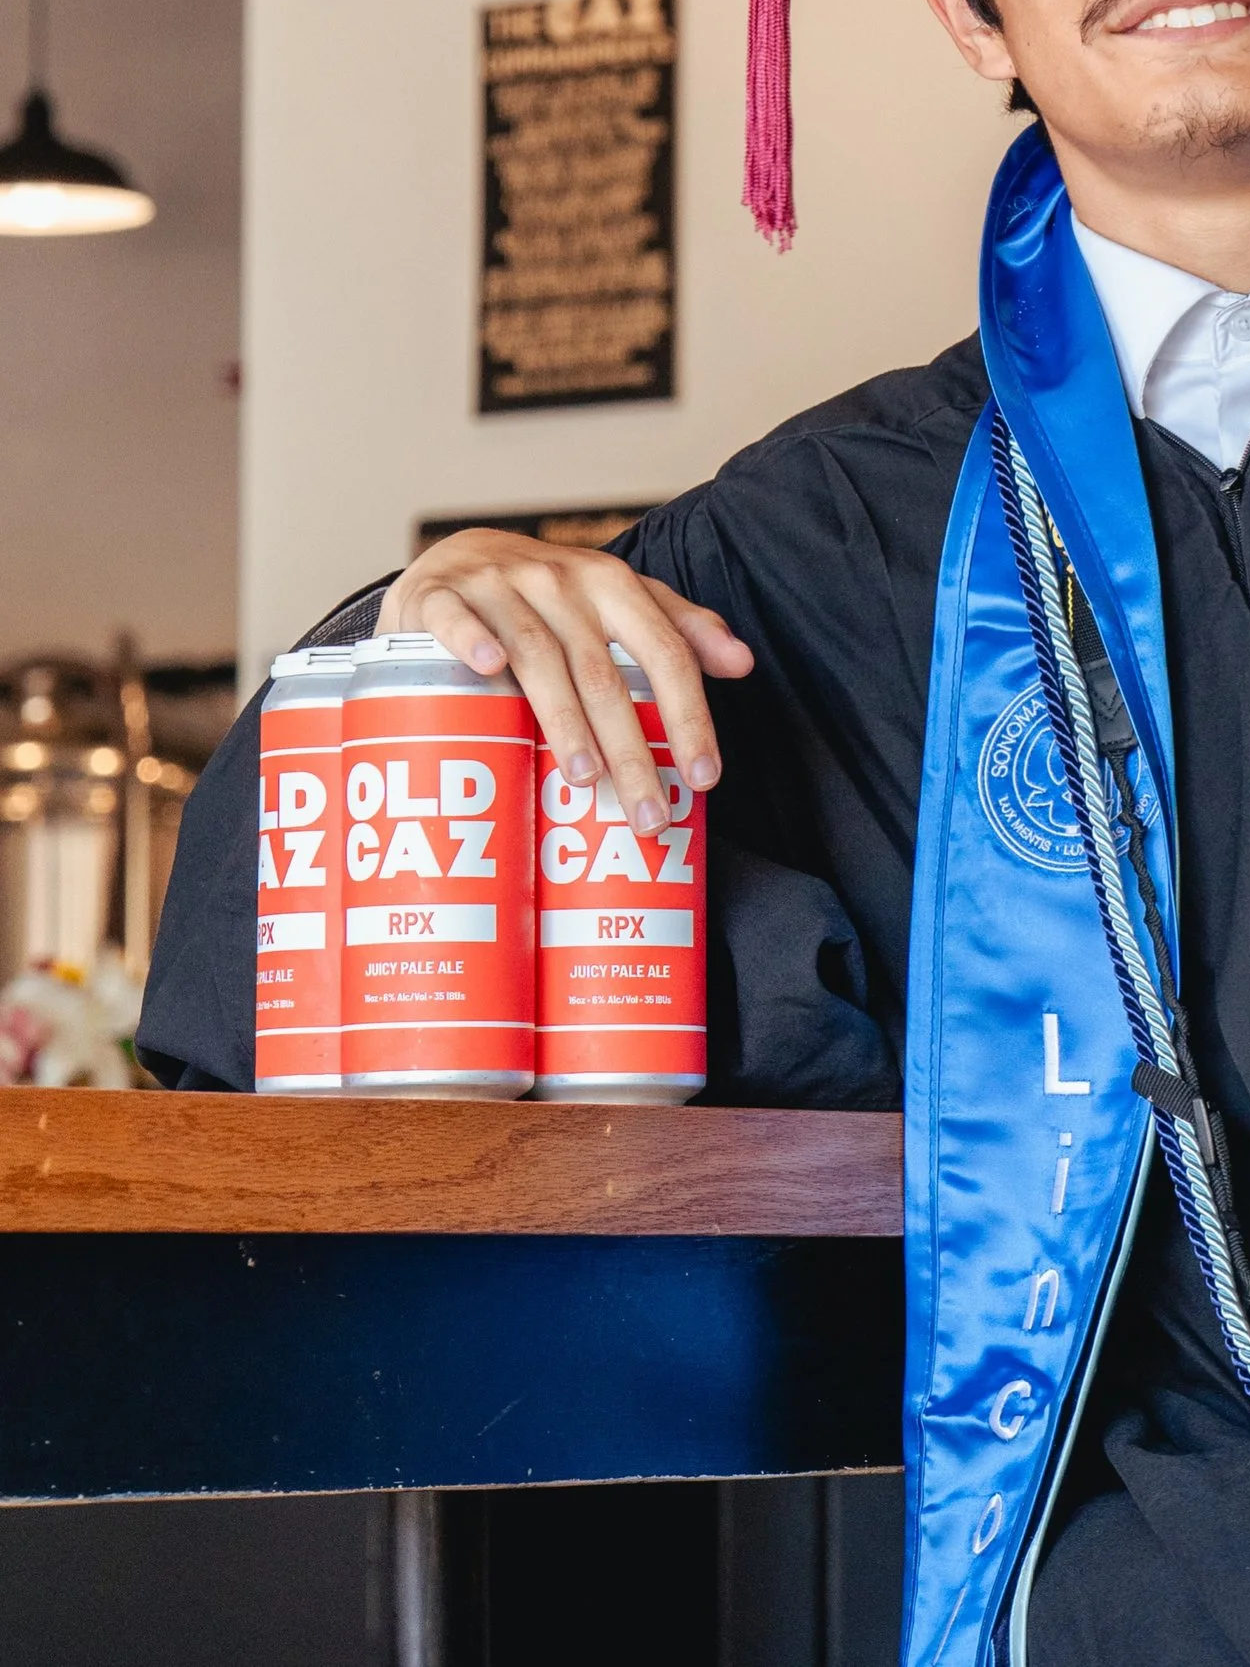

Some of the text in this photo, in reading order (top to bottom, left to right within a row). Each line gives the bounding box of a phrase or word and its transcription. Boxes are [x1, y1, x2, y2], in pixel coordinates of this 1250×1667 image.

[990, 698, 1048, 779] SONOMA
[258, 771, 328, 832] LD
[346, 759, 497, 822] OLD
[1010, 817, 1053, 853] MENTIS
[258, 830, 327, 892] AZ
[346, 820, 497, 883] CAZ
[540, 825, 694, 885] CAZ
[388, 911, 436, 936] RPX
[597, 915, 645, 939] RPX
[275, 968, 294, 983] ALE
[365, 960, 465, 977] JUICY PALE ALE
[569, 964, 671, 979] JUICY PALE ALE
[383, 992, 396, 1003] 6%
[591, 995, 605, 1005] 6%
